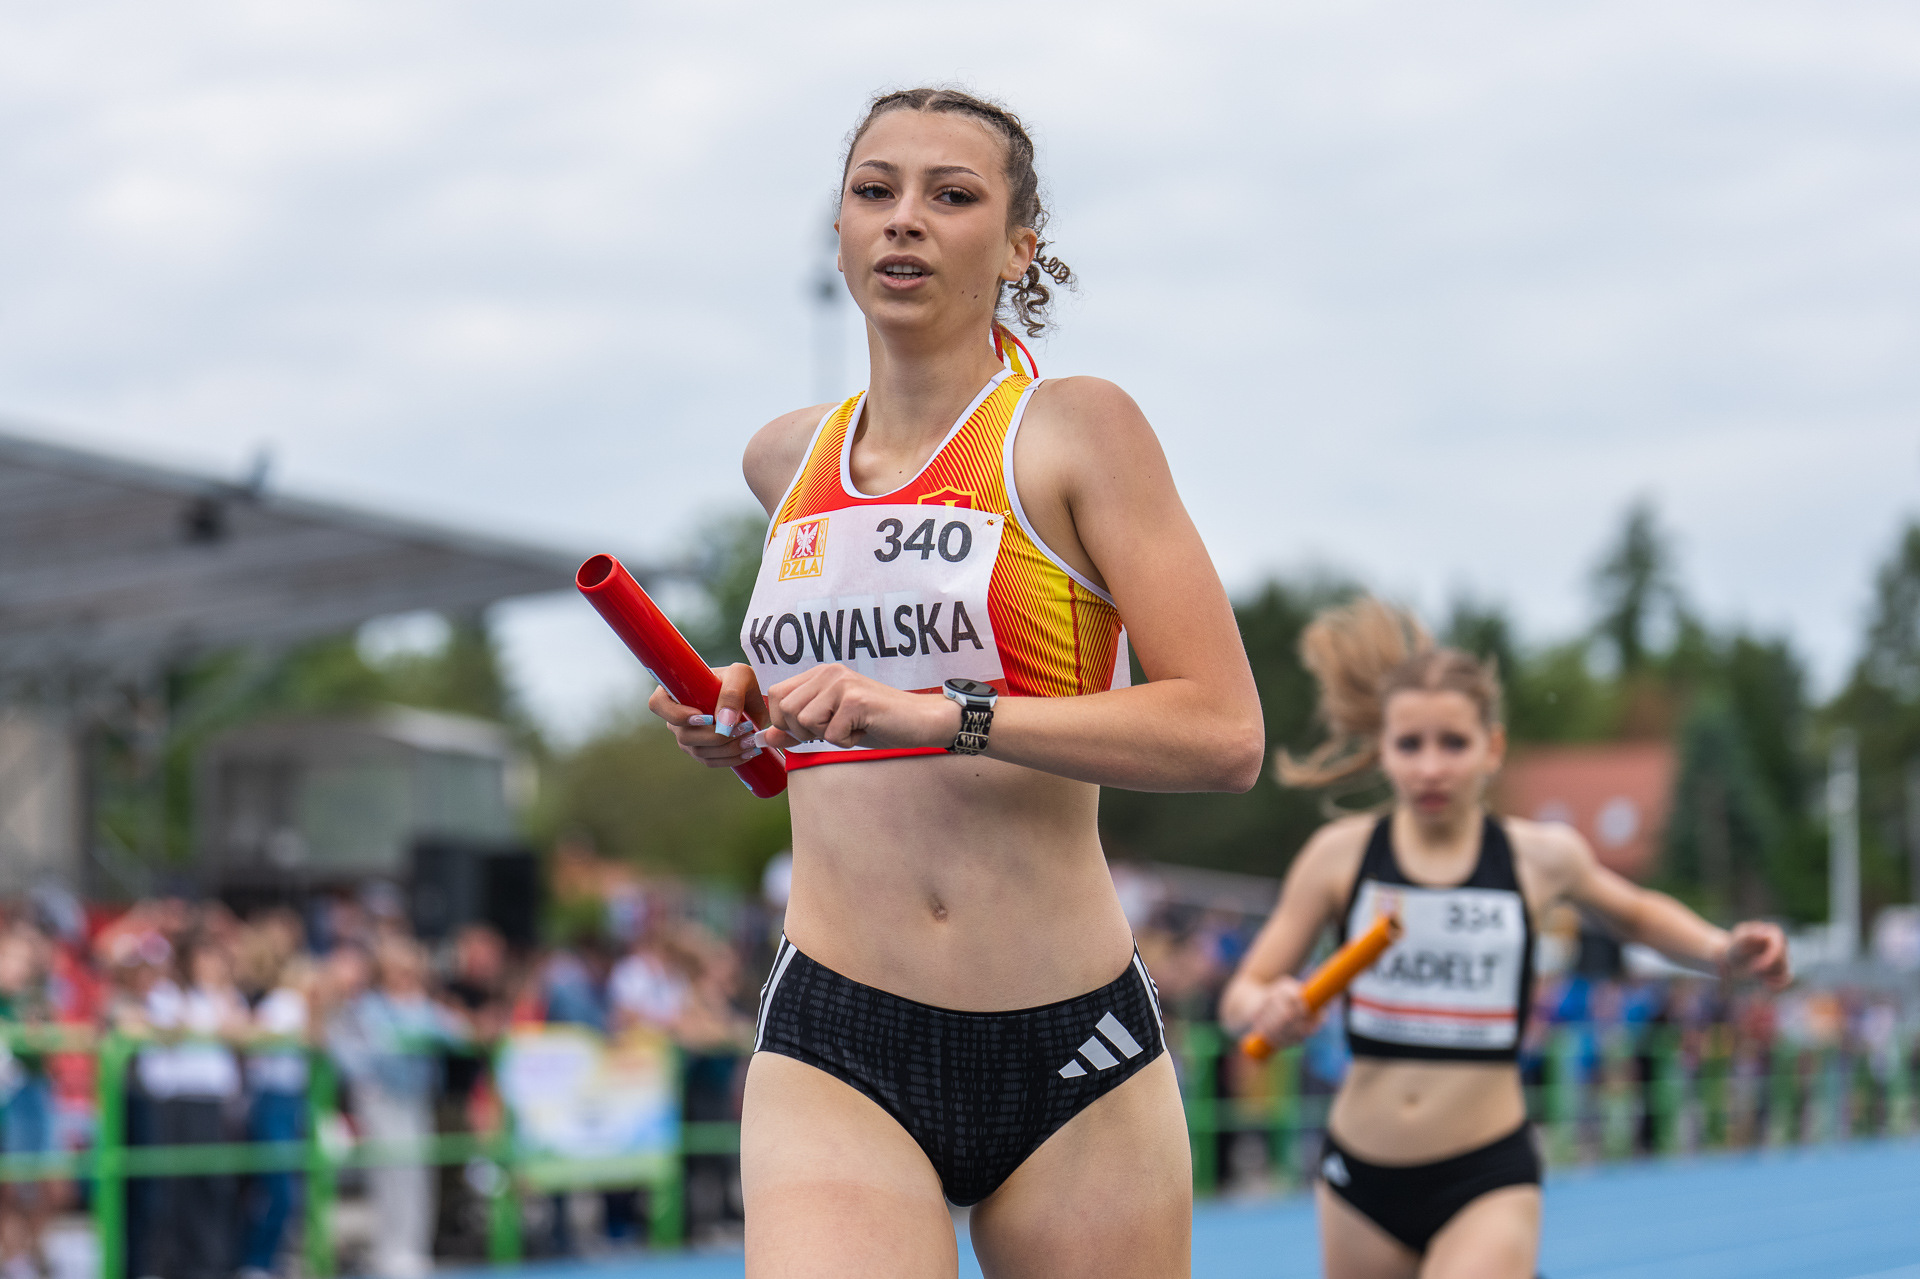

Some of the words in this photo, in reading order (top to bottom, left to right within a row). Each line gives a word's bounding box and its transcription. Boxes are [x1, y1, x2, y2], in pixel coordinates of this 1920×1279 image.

[873, 517, 973, 563] 340
[781, 558, 820, 578] PZLA
[749, 601, 984, 665] KOWALSKA
